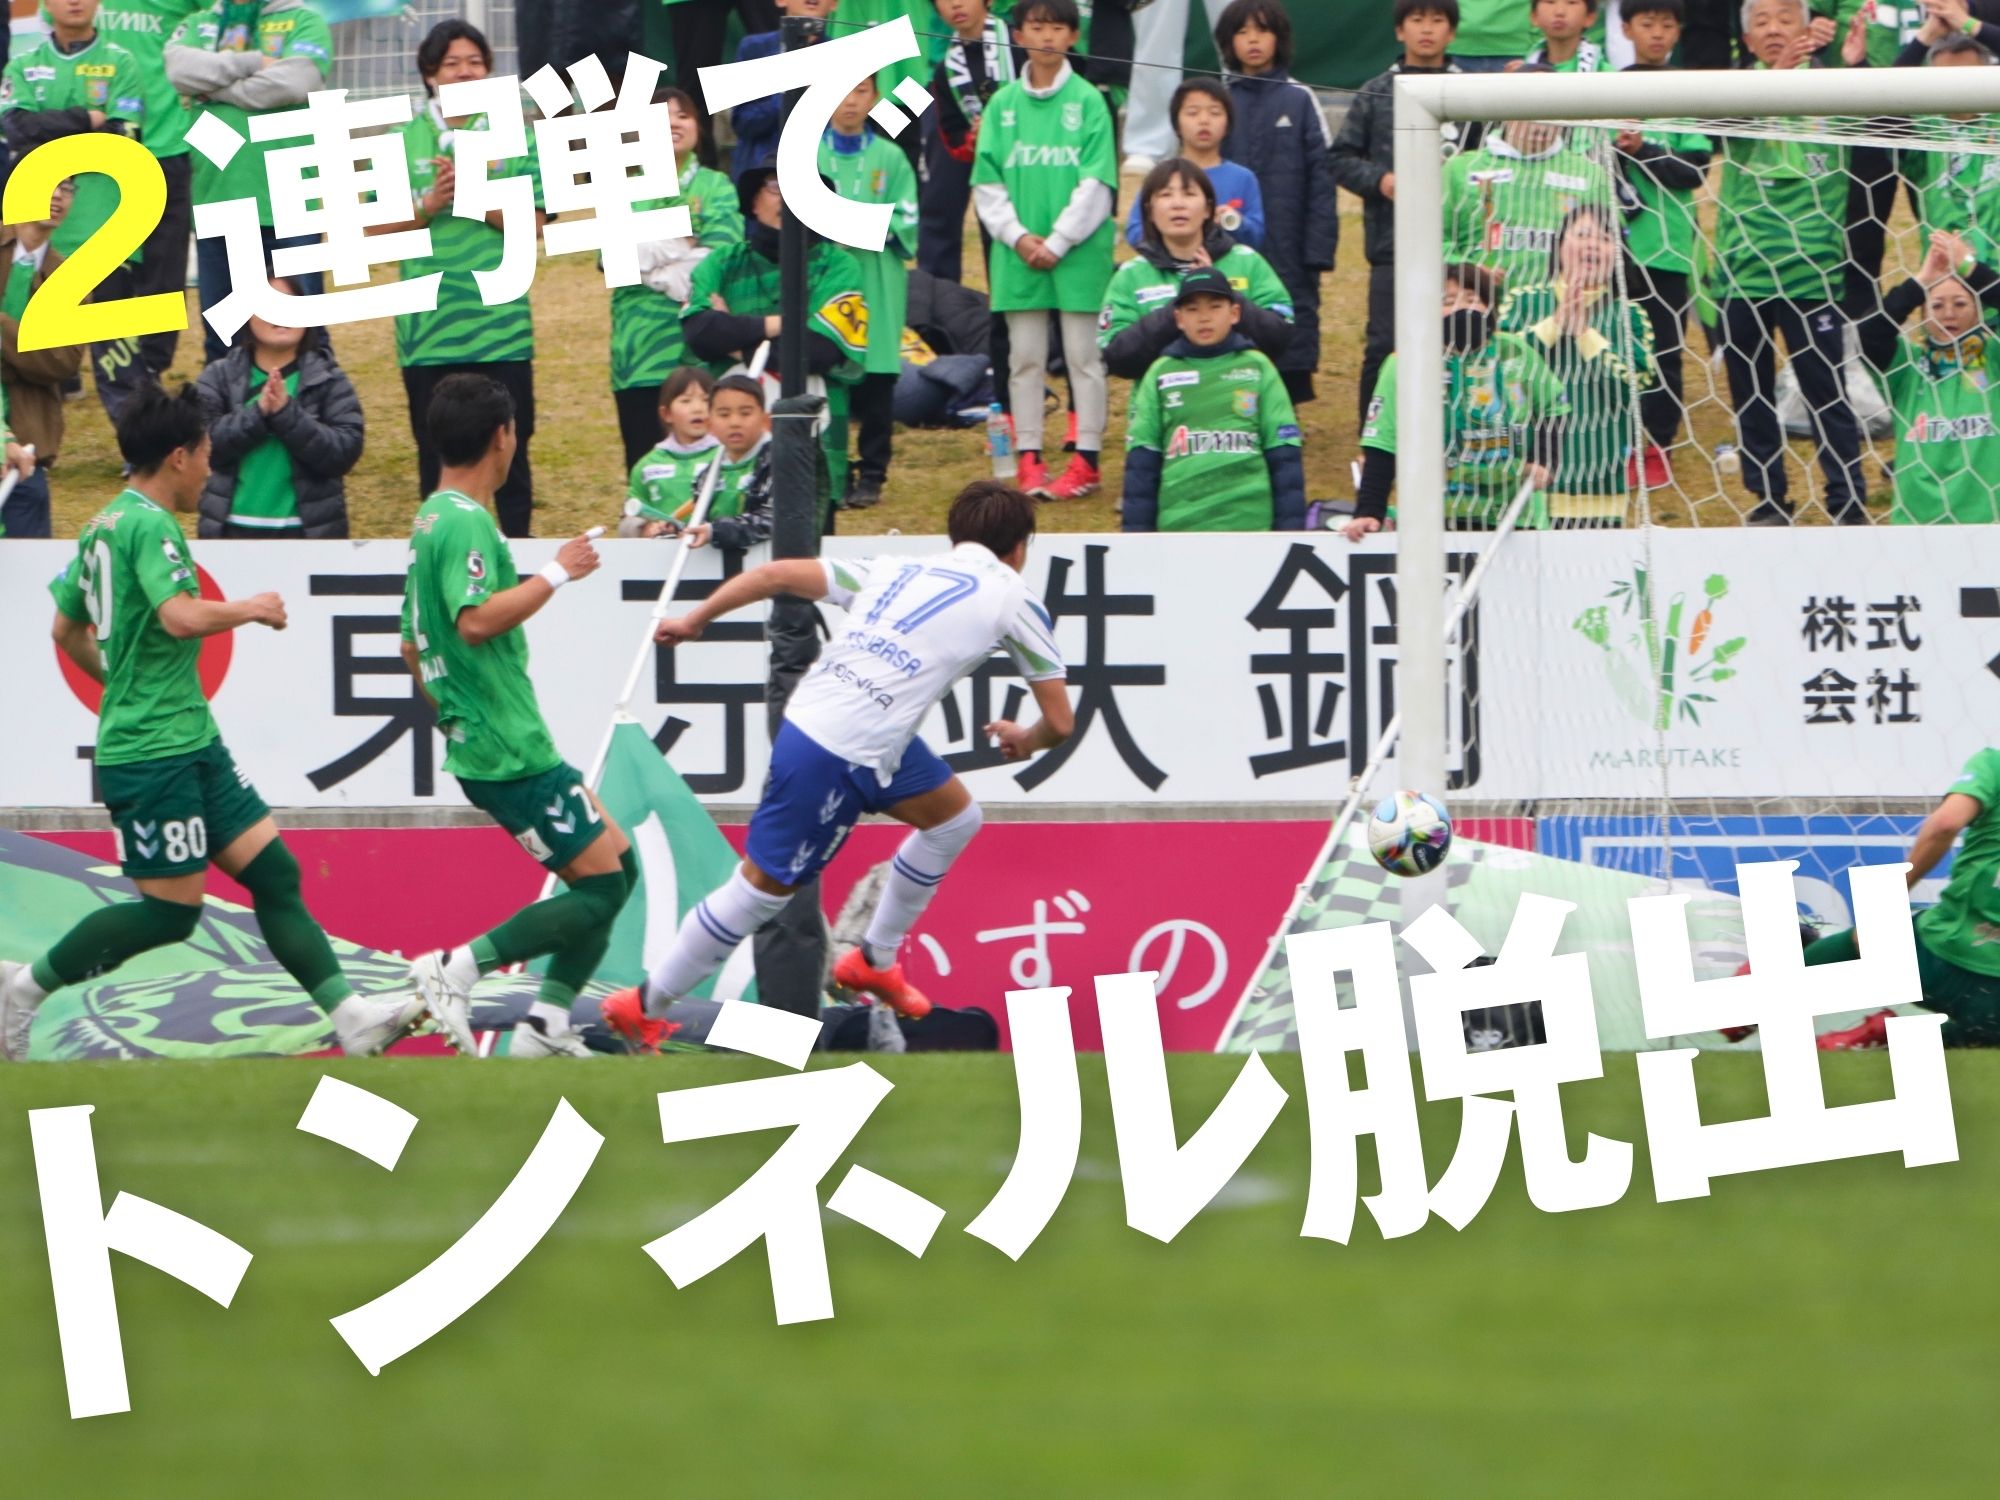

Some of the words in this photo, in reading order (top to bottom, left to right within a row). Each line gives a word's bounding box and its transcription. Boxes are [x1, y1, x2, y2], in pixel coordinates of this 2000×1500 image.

[1003, 141, 1082, 168] ATMIX
[1165, 425, 1258, 459] ATMIX
[1904, 412, 1996, 443] ATMIX
[864, 563, 980, 636] 17
[1801, 594, 1923, 653] 株式
[1801, 666, 1923, 725] 会社
[1588, 747, 1742, 770] MARUTAKE
[164, 815, 208, 865] 80
